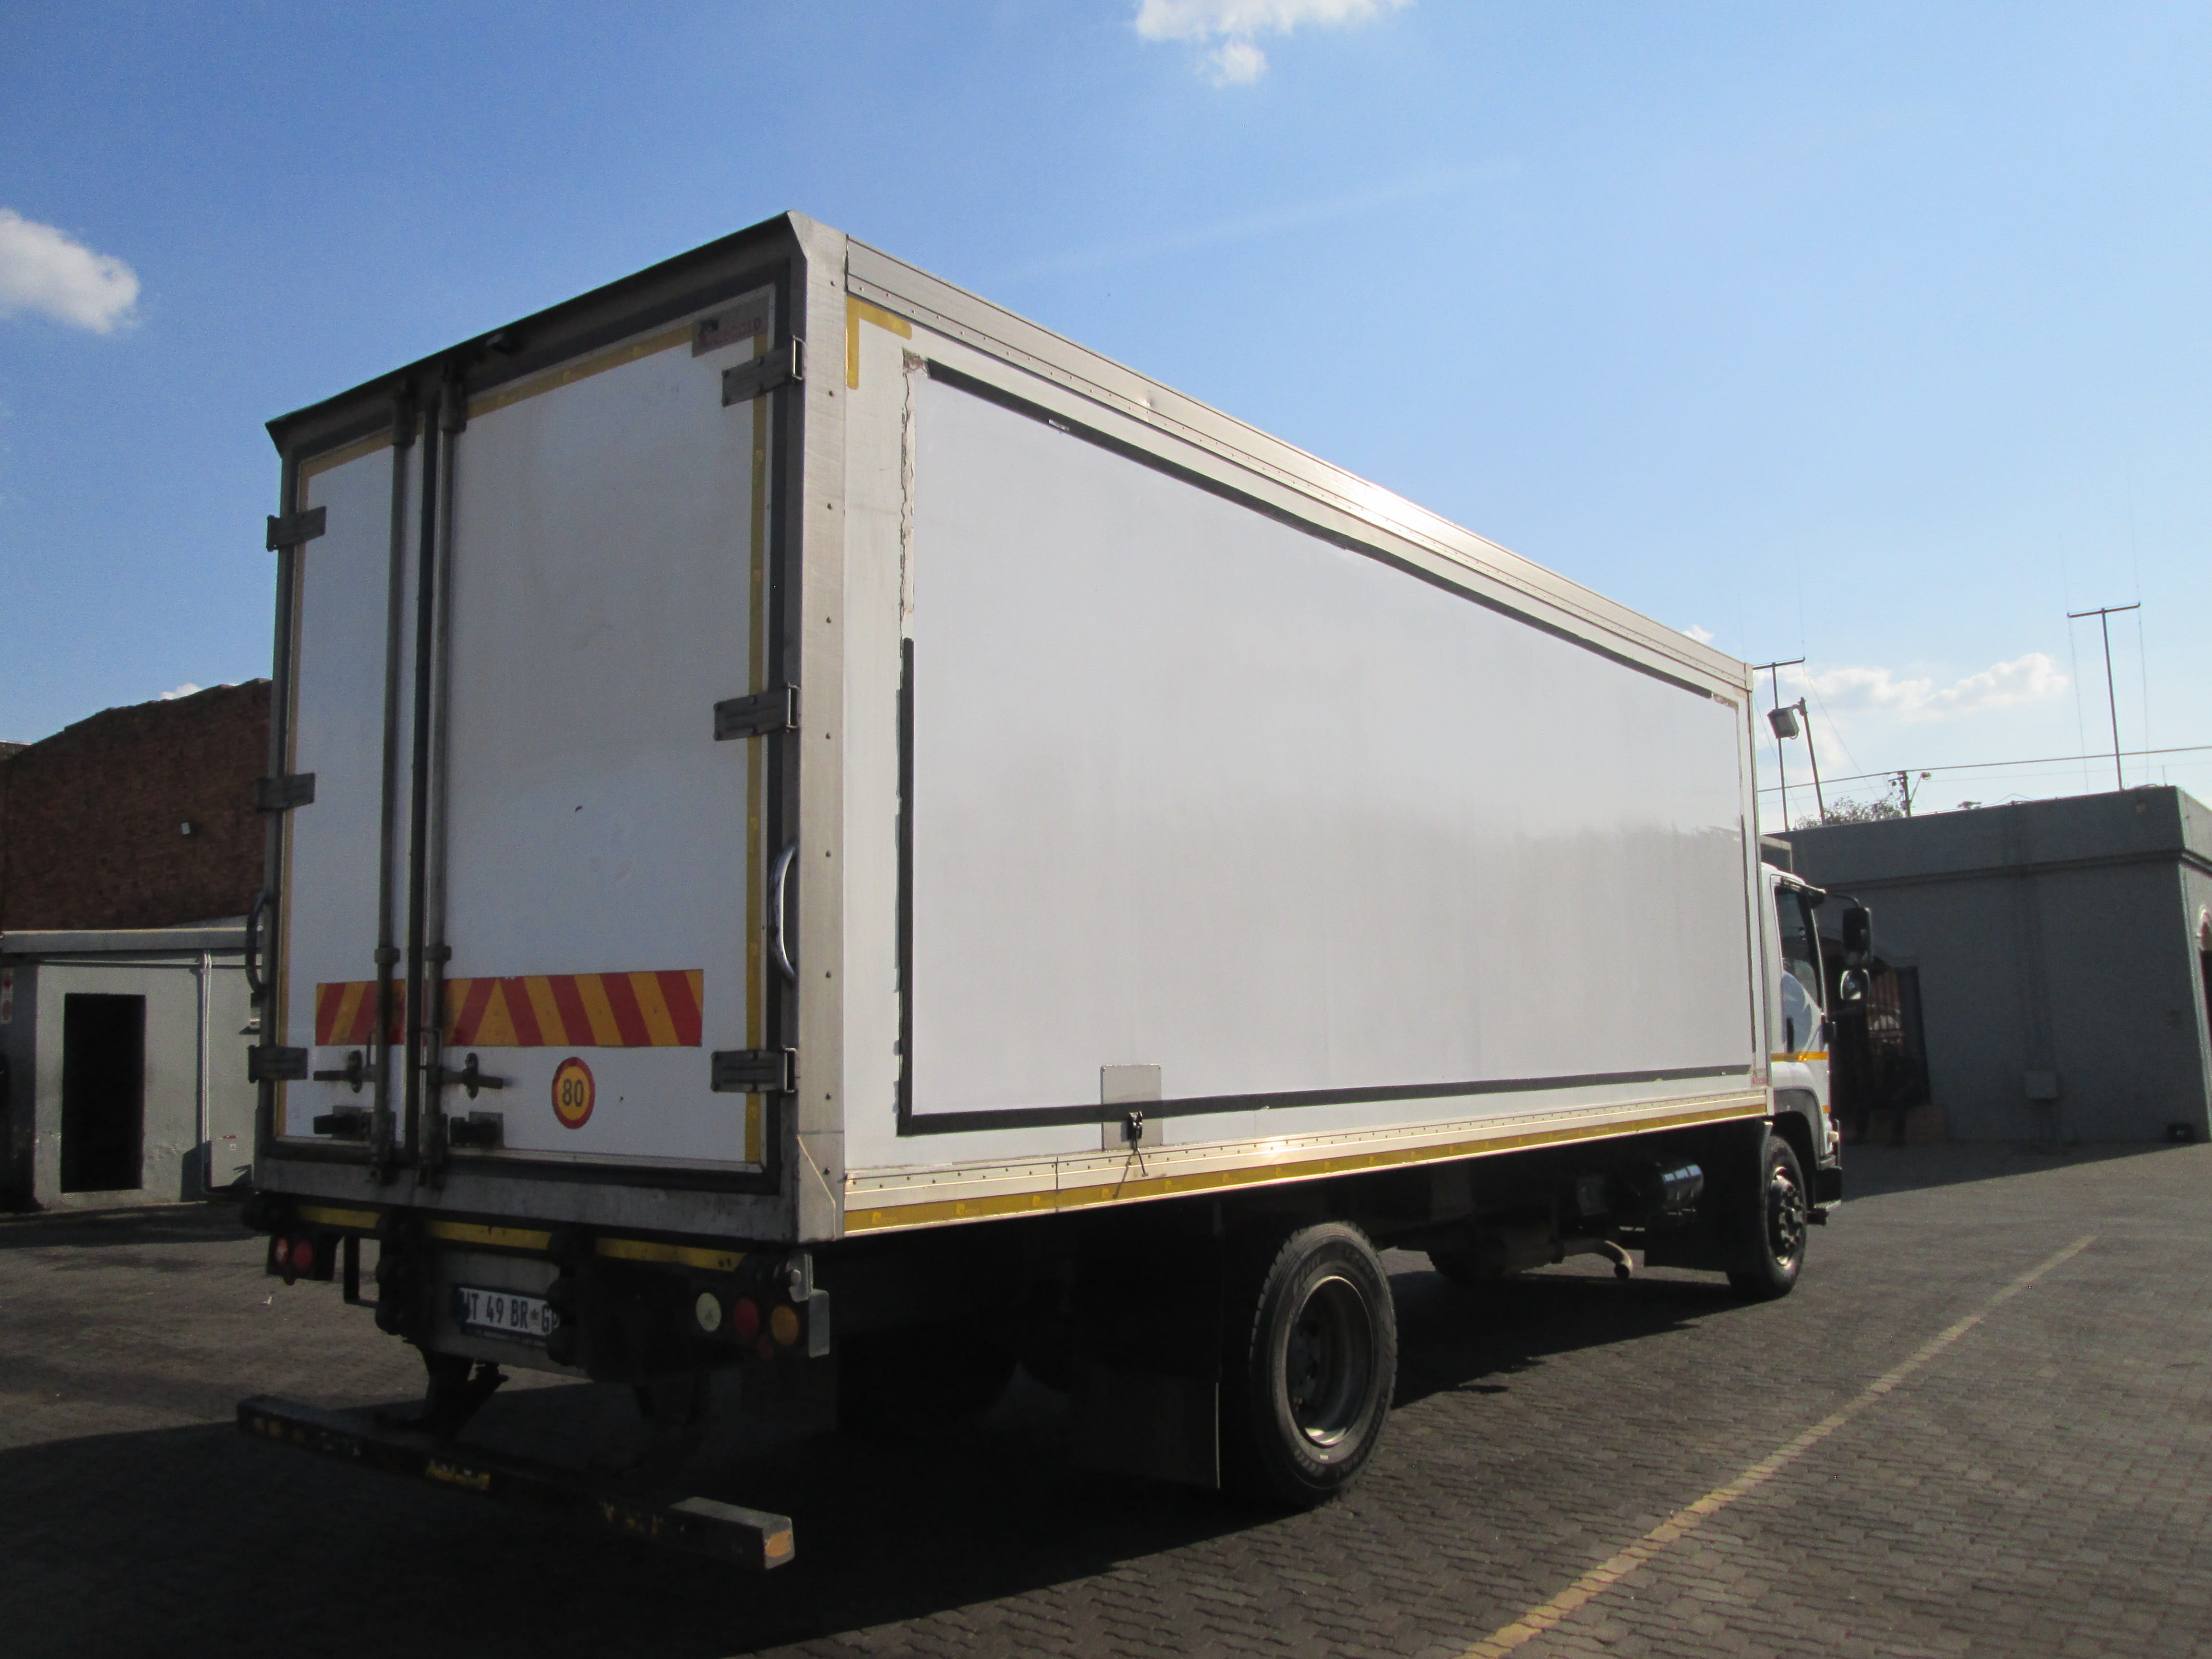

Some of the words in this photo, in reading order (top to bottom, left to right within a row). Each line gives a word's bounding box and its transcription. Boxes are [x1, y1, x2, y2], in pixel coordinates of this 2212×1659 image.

[563, 1078, 584, 1106] 80
[486, 1295, 504, 1323] 49
[510, 1299, 528, 1329] BR
